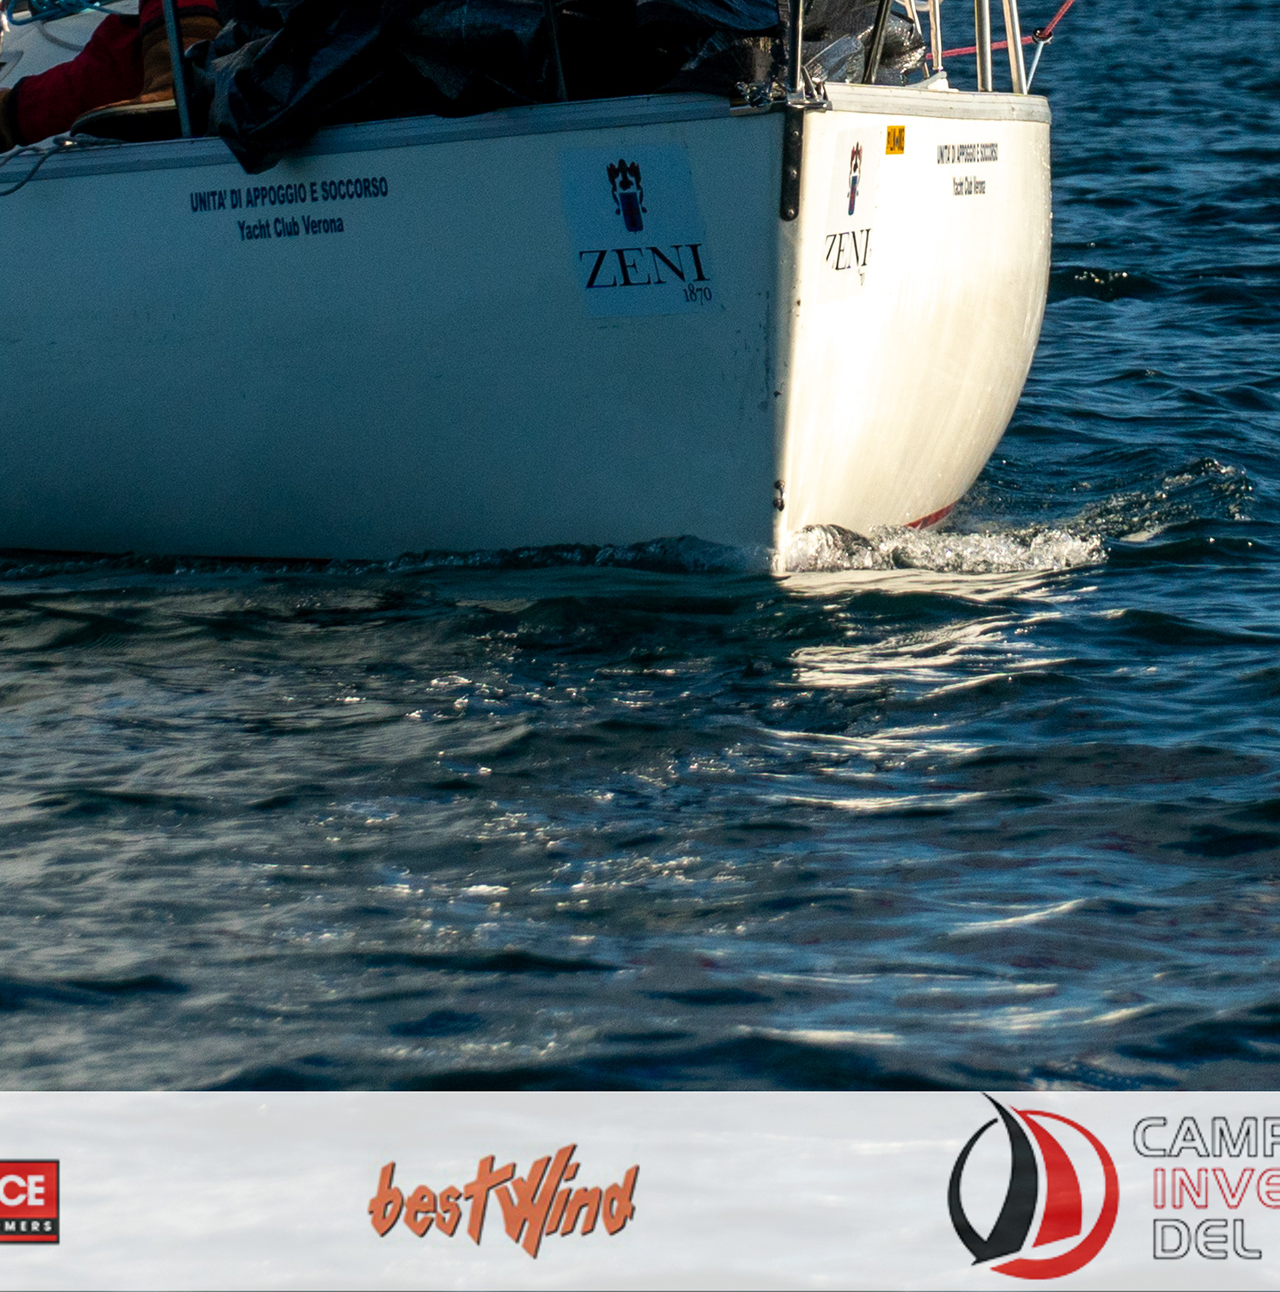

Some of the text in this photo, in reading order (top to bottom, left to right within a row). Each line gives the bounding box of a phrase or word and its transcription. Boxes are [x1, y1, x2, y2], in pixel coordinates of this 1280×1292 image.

[190, 176, 389, 212] UNITA' DI APPOGGIO E SOCCORSO
[237, 215, 344, 241] Yacht Club Verona
[579, 243, 710, 288] ZENI
[825, 228, 872, 270] ZENI
[683, 283, 712, 305] 1870
